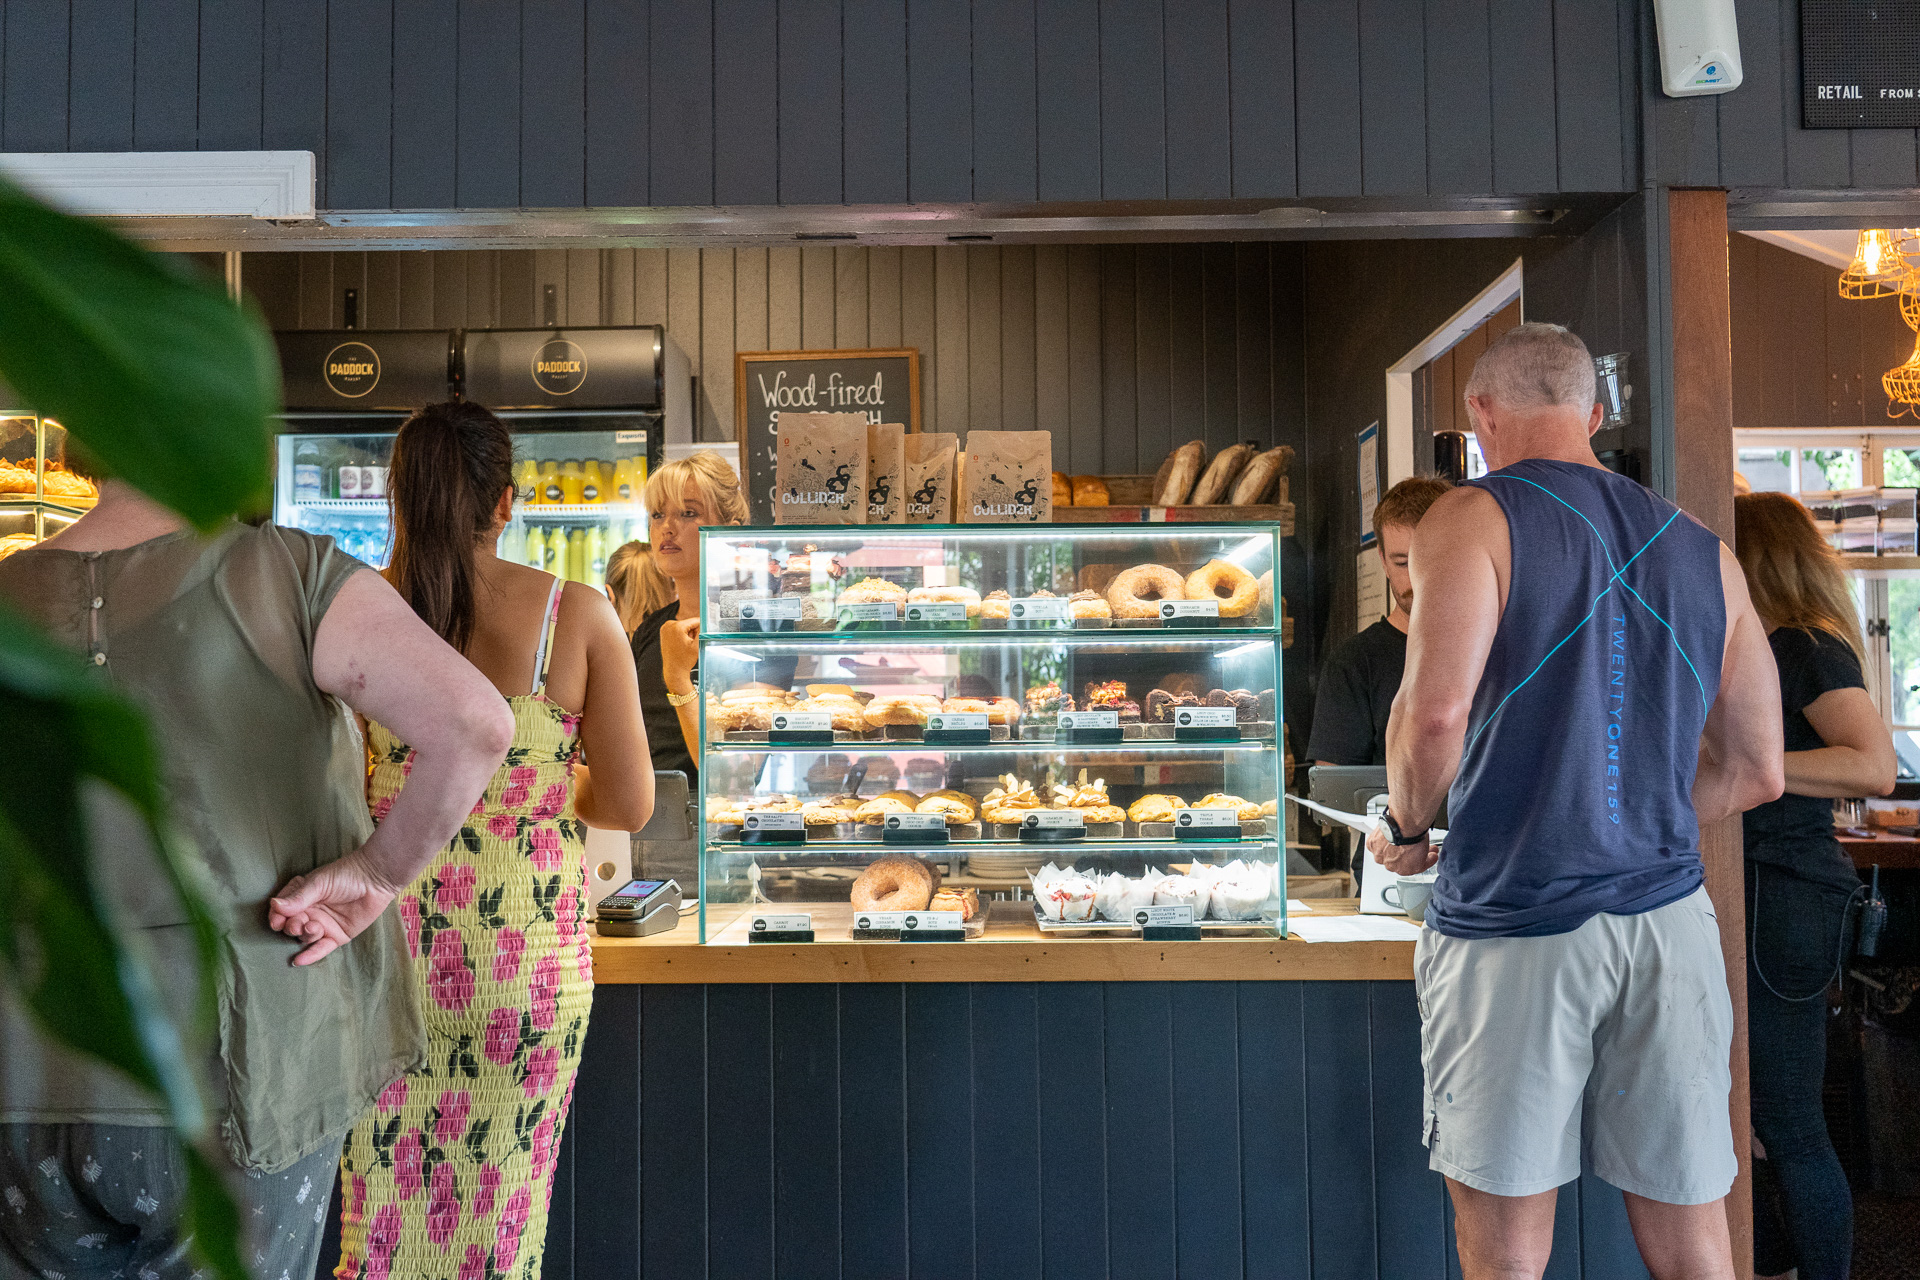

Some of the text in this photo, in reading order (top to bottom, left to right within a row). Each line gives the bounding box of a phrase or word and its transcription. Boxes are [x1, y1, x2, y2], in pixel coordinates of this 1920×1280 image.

[1818, 85, 1863, 99] RETAIL
[1880, 89, 1914, 98] FROM
[330, 363, 374, 375] PADDOCK
[537, 361, 581, 373] PADDOCK
[758, 370, 885, 408] Wood-fired
[782, 491, 845, 505] COLLIDER
[973, 504, 1033, 516] COLLIDER
